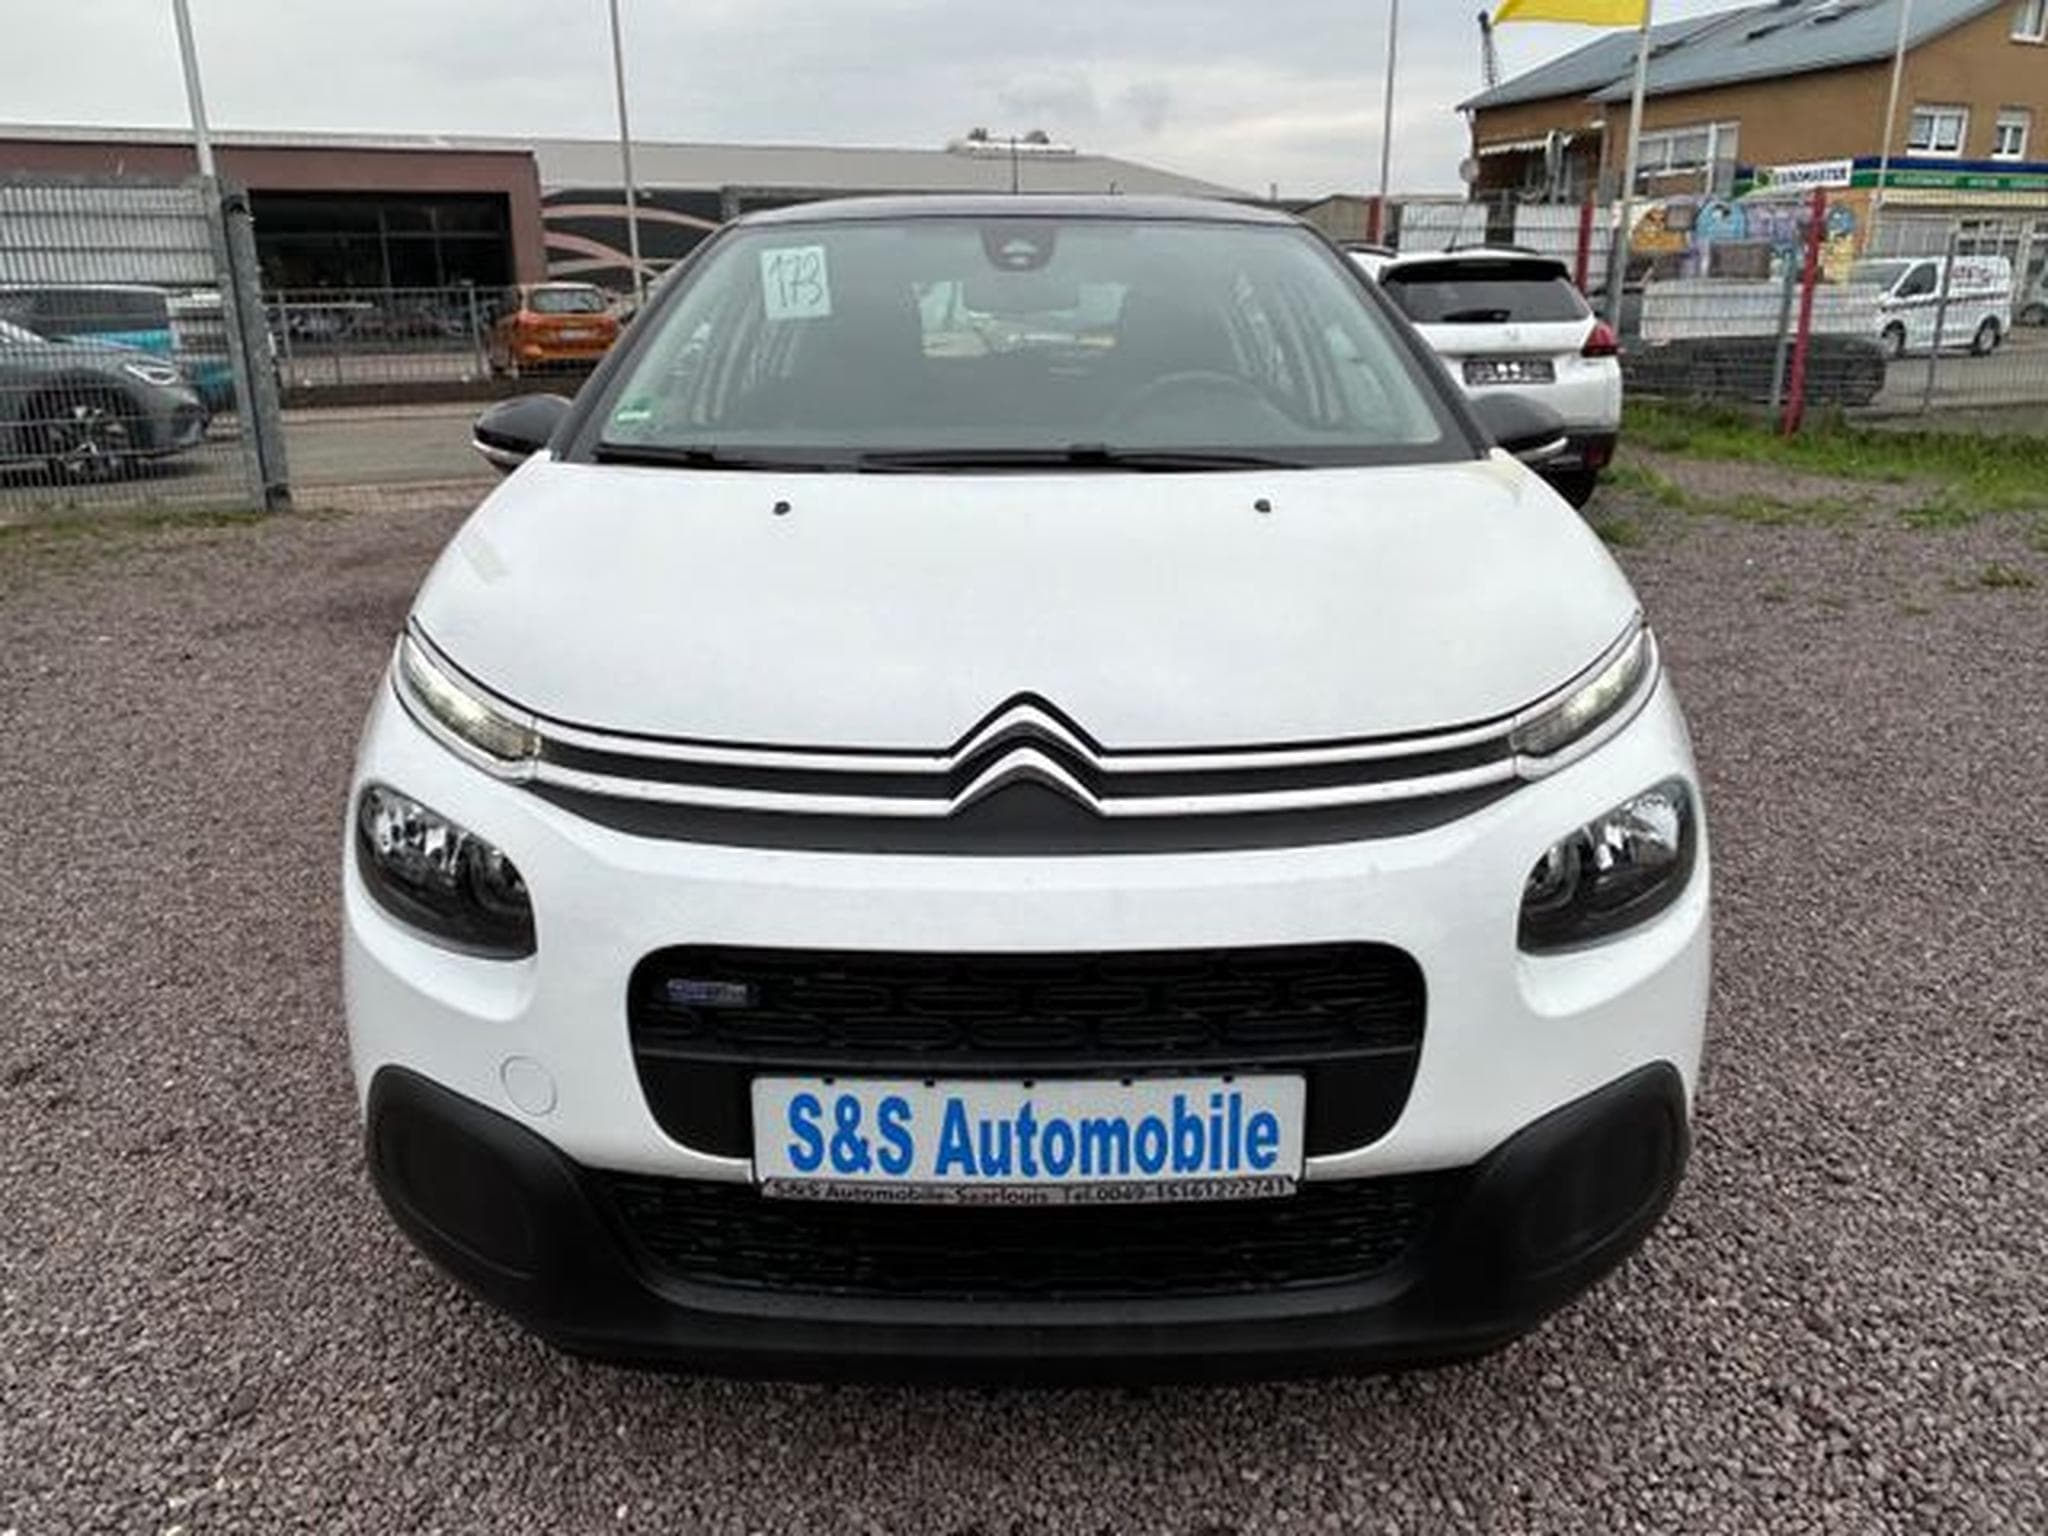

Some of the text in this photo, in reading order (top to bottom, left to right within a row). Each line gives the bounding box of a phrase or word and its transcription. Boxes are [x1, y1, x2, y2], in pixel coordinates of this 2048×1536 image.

[767, 251, 824, 308] 173
[787, 1091, 1281, 1178] S&S Automobile
